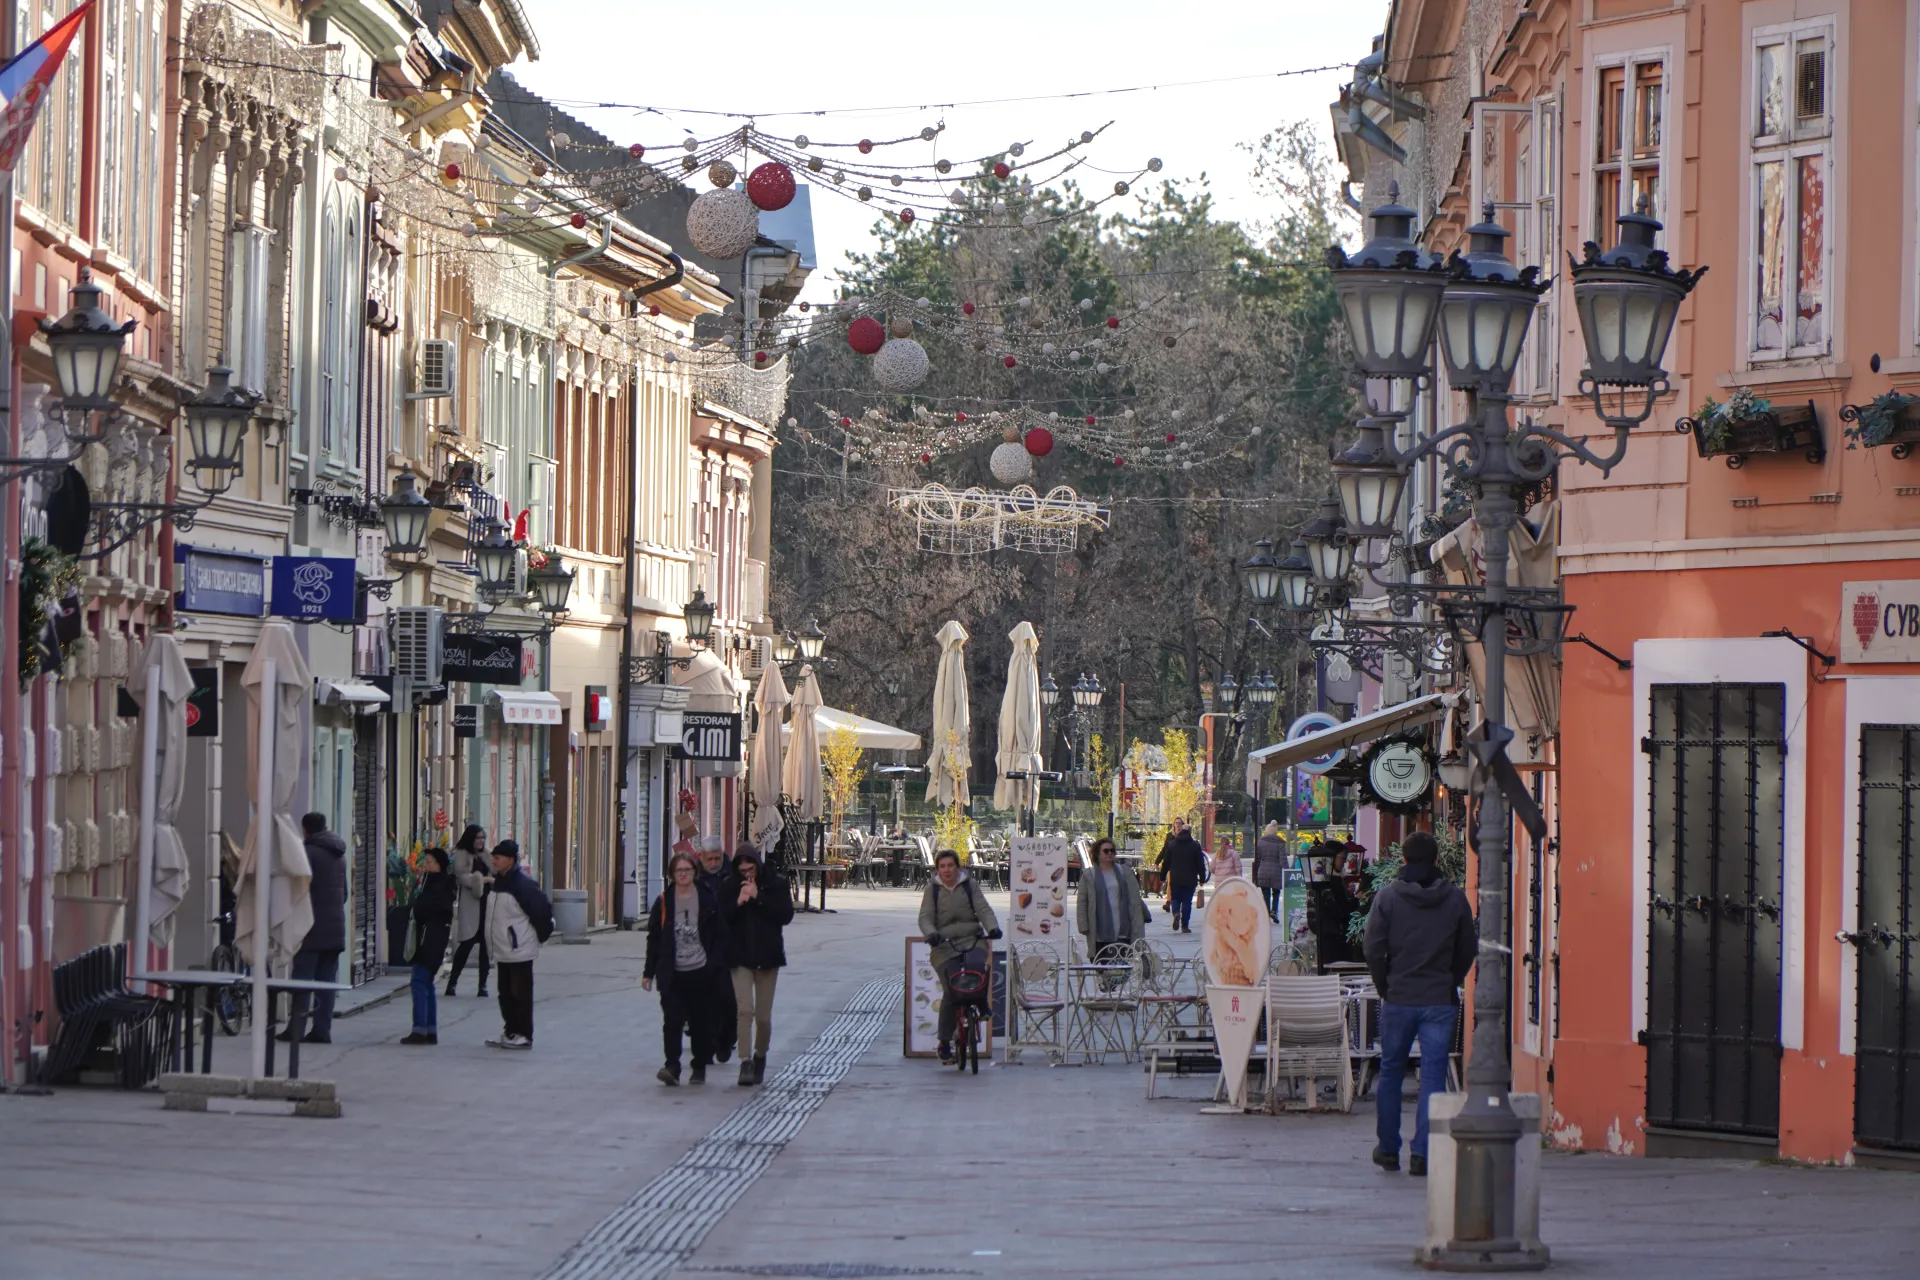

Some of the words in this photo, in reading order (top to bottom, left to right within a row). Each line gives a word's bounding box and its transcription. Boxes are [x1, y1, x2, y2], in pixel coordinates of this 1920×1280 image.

[301, 604, 323, 614] 1921
[443, 647, 467, 659] YSTAL
[443, 657, 467, 666] ENCE
[683, 715, 732, 726] RESTORAN
[1387, 782, 1412, 790] GABBY
[1026, 842, 1052, 851] GABBY
